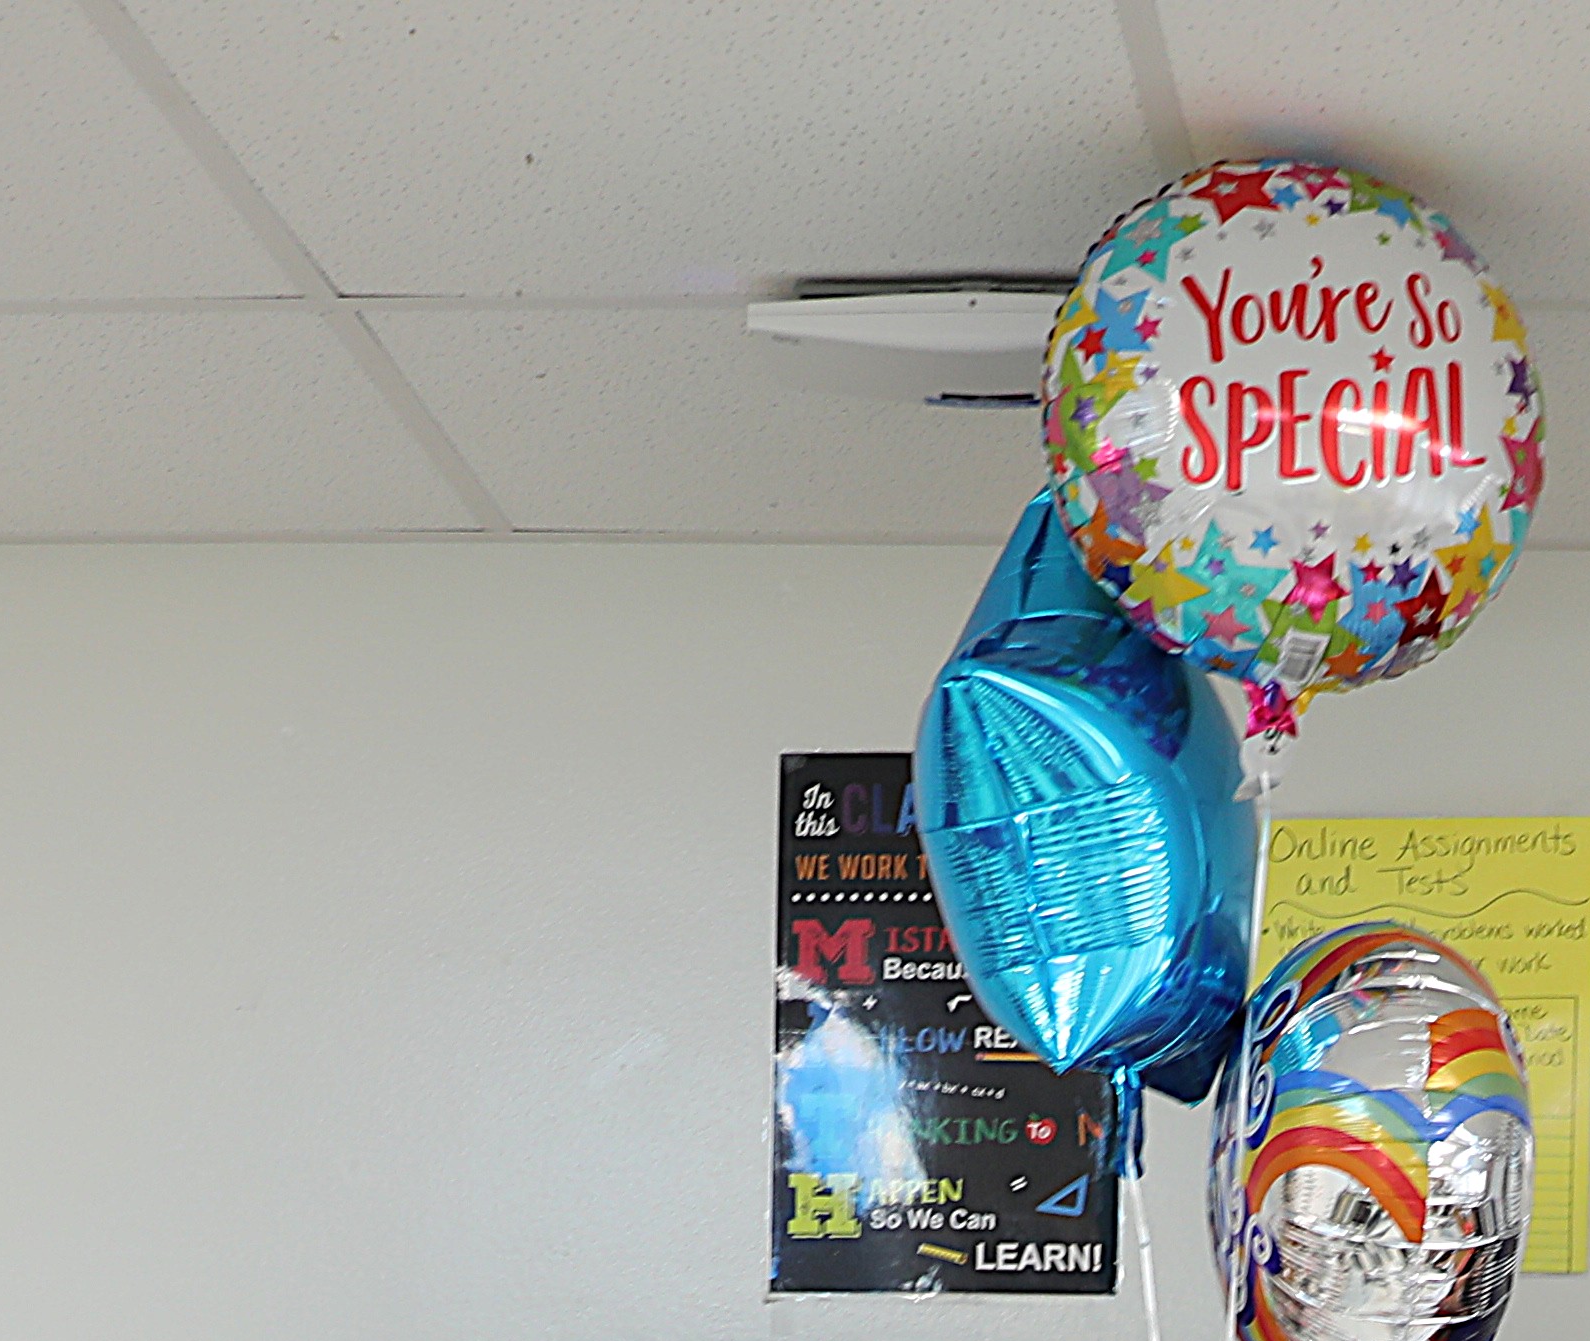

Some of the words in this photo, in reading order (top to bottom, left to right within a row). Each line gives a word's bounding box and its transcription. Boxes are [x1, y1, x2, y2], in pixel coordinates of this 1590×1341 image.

[1181, 256, 1394, 363] You're
[1407, 273, 1461, 349] So
[1179, 360, 1488, 492] SPECIAL
[794, 808, 841, 837] this
[1270, 827, 1377, 863] Online
[1399, 825, 1576, 873] Assignments
[795, 855, 830, 880] WE
[838, 854, 908, 880] WORK
[1297, 868, 1357, 896] and
[1377, 868, 1469, 896] Tests
[869, 1211, 898, 1230] So
[905, 1211, 944, 1230] We
[949, 1212, 996, 1231] Can
[975, 1243, 1103, 1272] LEARN!
